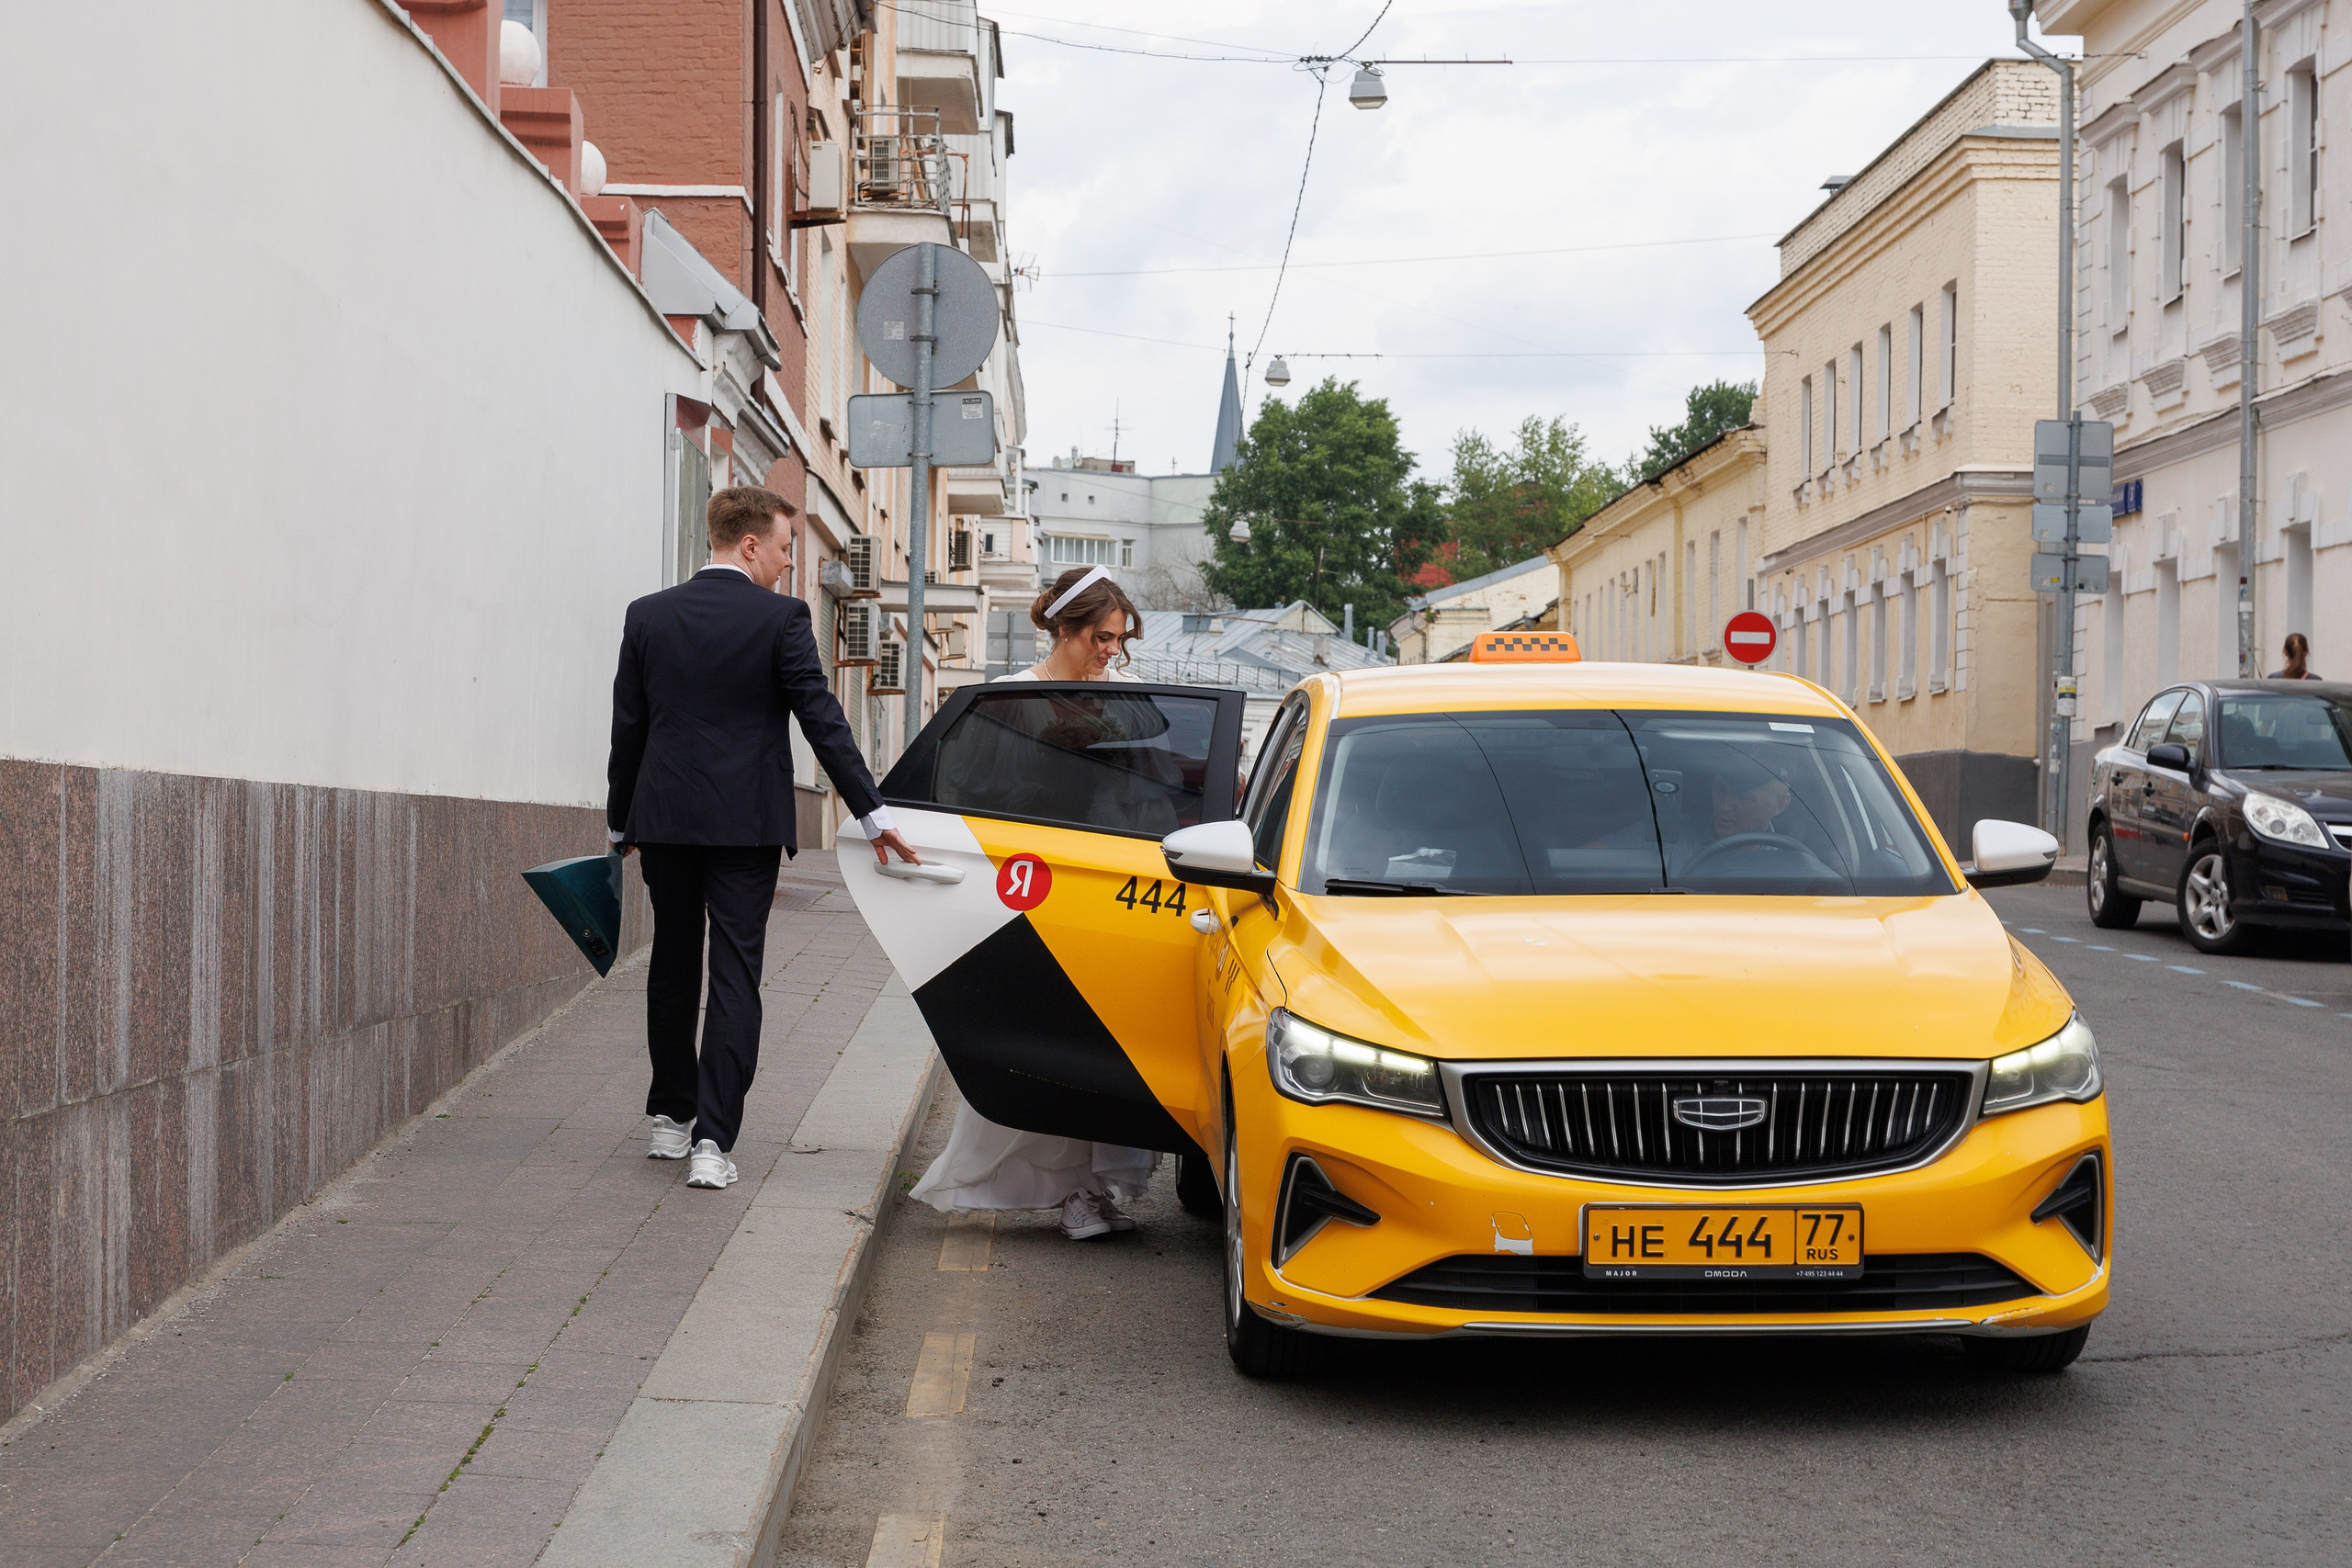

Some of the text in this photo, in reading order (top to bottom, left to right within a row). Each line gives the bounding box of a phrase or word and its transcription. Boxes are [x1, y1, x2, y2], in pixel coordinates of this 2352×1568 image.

[1005, 860, 1034, 897] Я
[1115, 875, 1186, 917] 444
[1689, 1215, 1771, 1258] 444
[1802, 1213, 1845, 1246] 77
[1806, 1247, 1838, 1260] RUS
